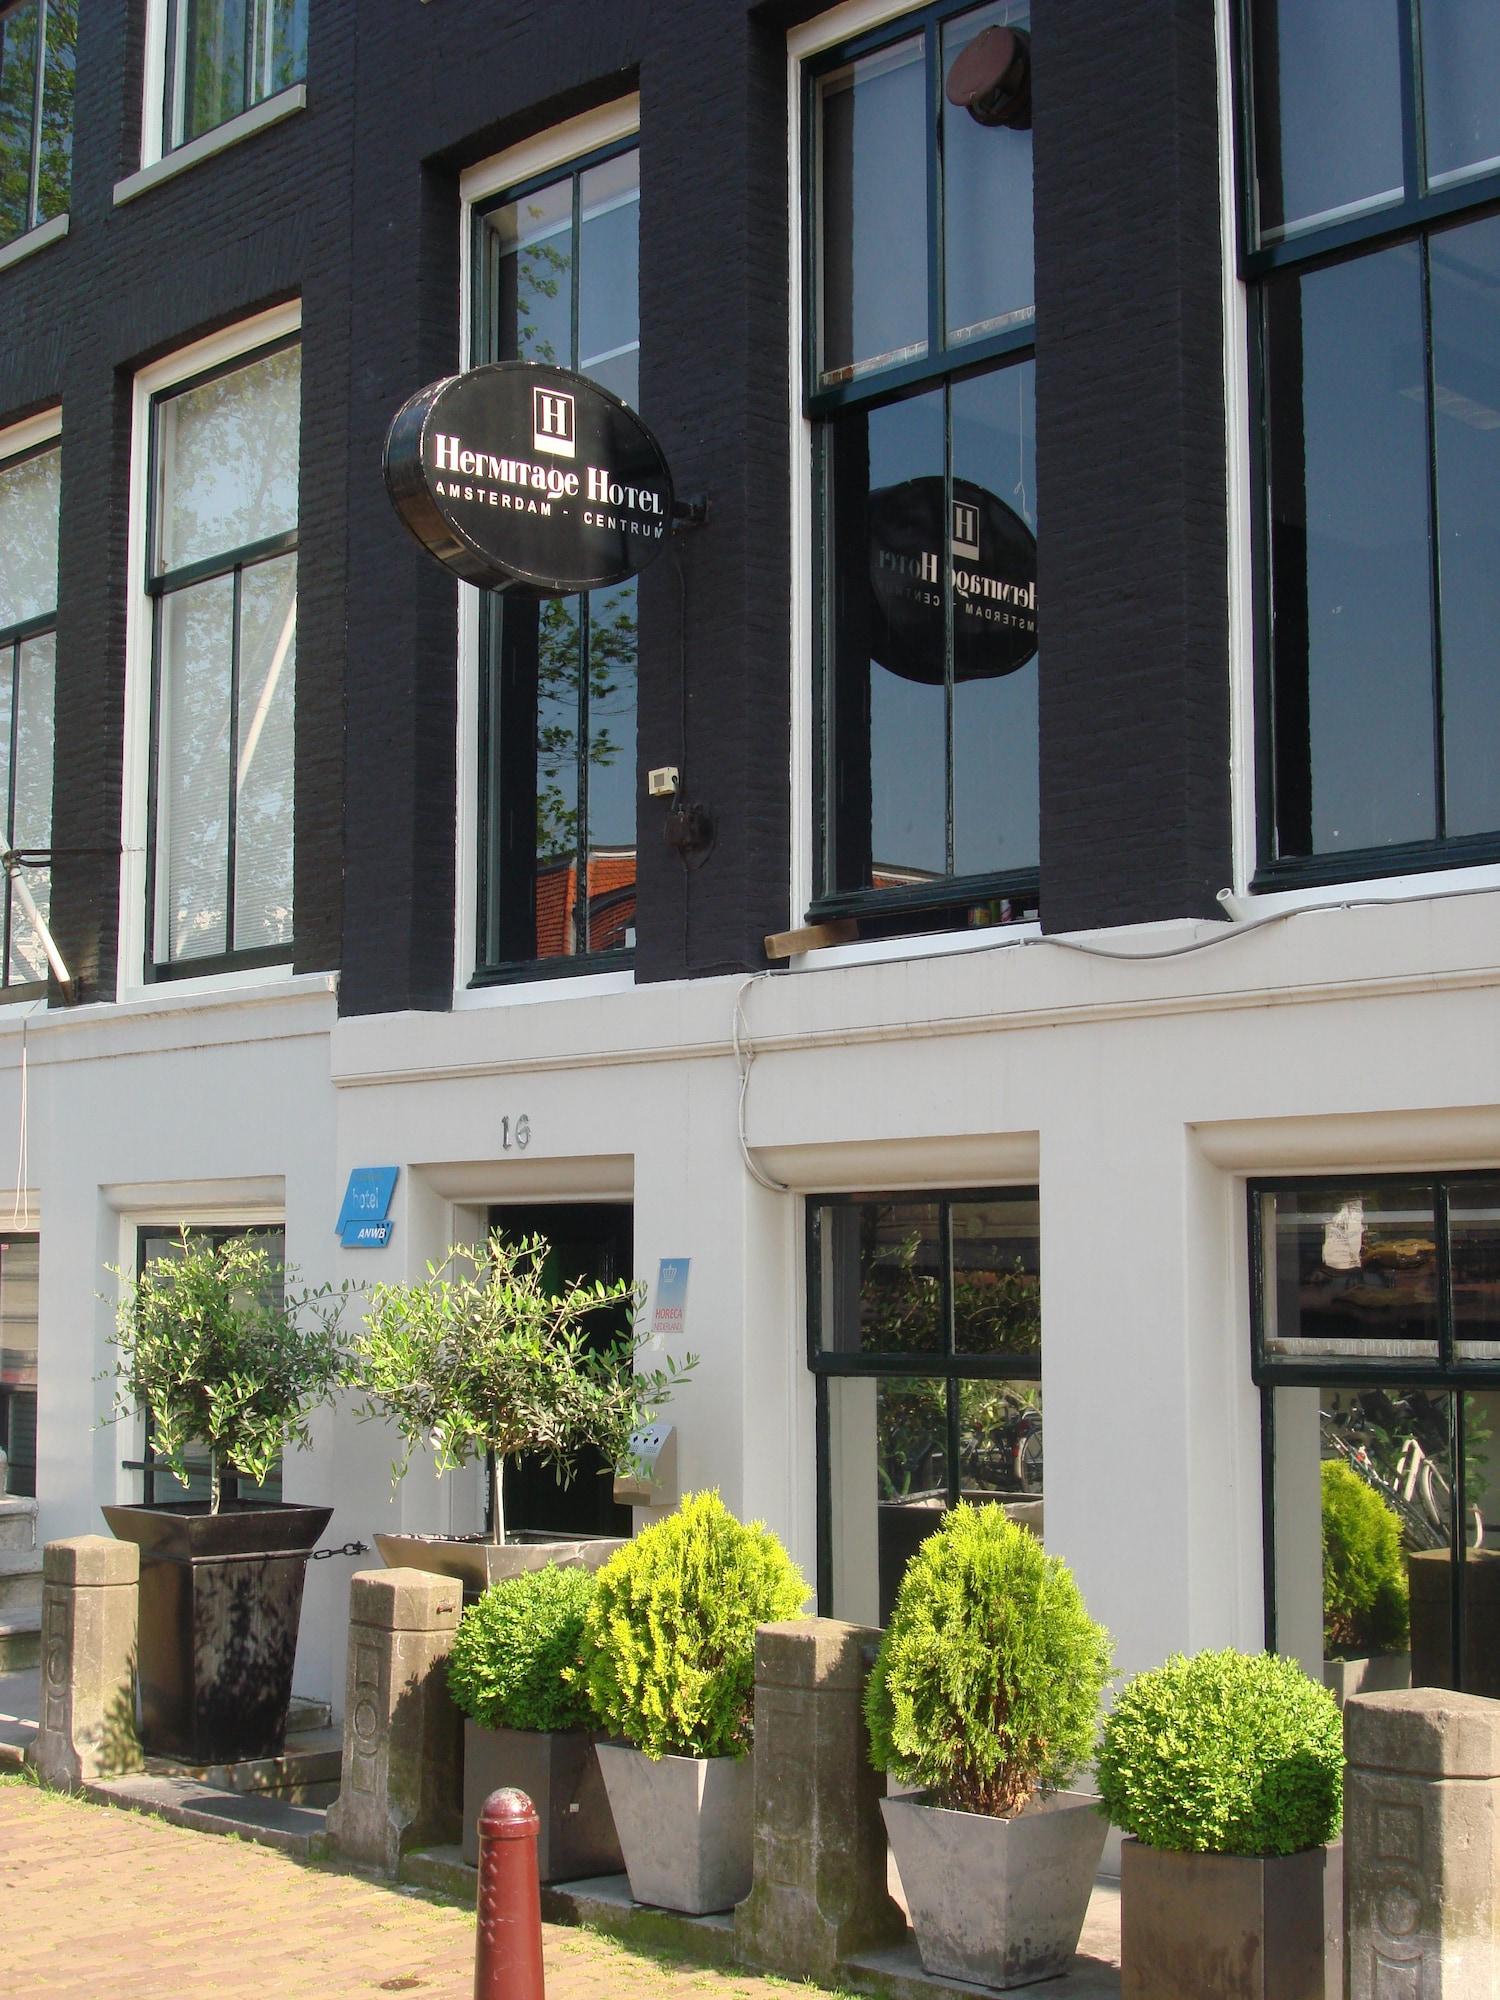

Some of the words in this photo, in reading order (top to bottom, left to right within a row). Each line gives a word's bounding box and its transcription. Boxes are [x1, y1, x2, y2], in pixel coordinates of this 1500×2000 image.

[541, 395, 567, 436] H
[435, 481, 551, 516] AMSTERDAM
[583, 511, 664, 539] CENTRUM
[501, 1114, 531, 1150] 16
[352, 1187, 379, 1209] hotel
[357, 1227, 386, 1239] ANWB
[655, 1307, 682, 1319] HORECA
